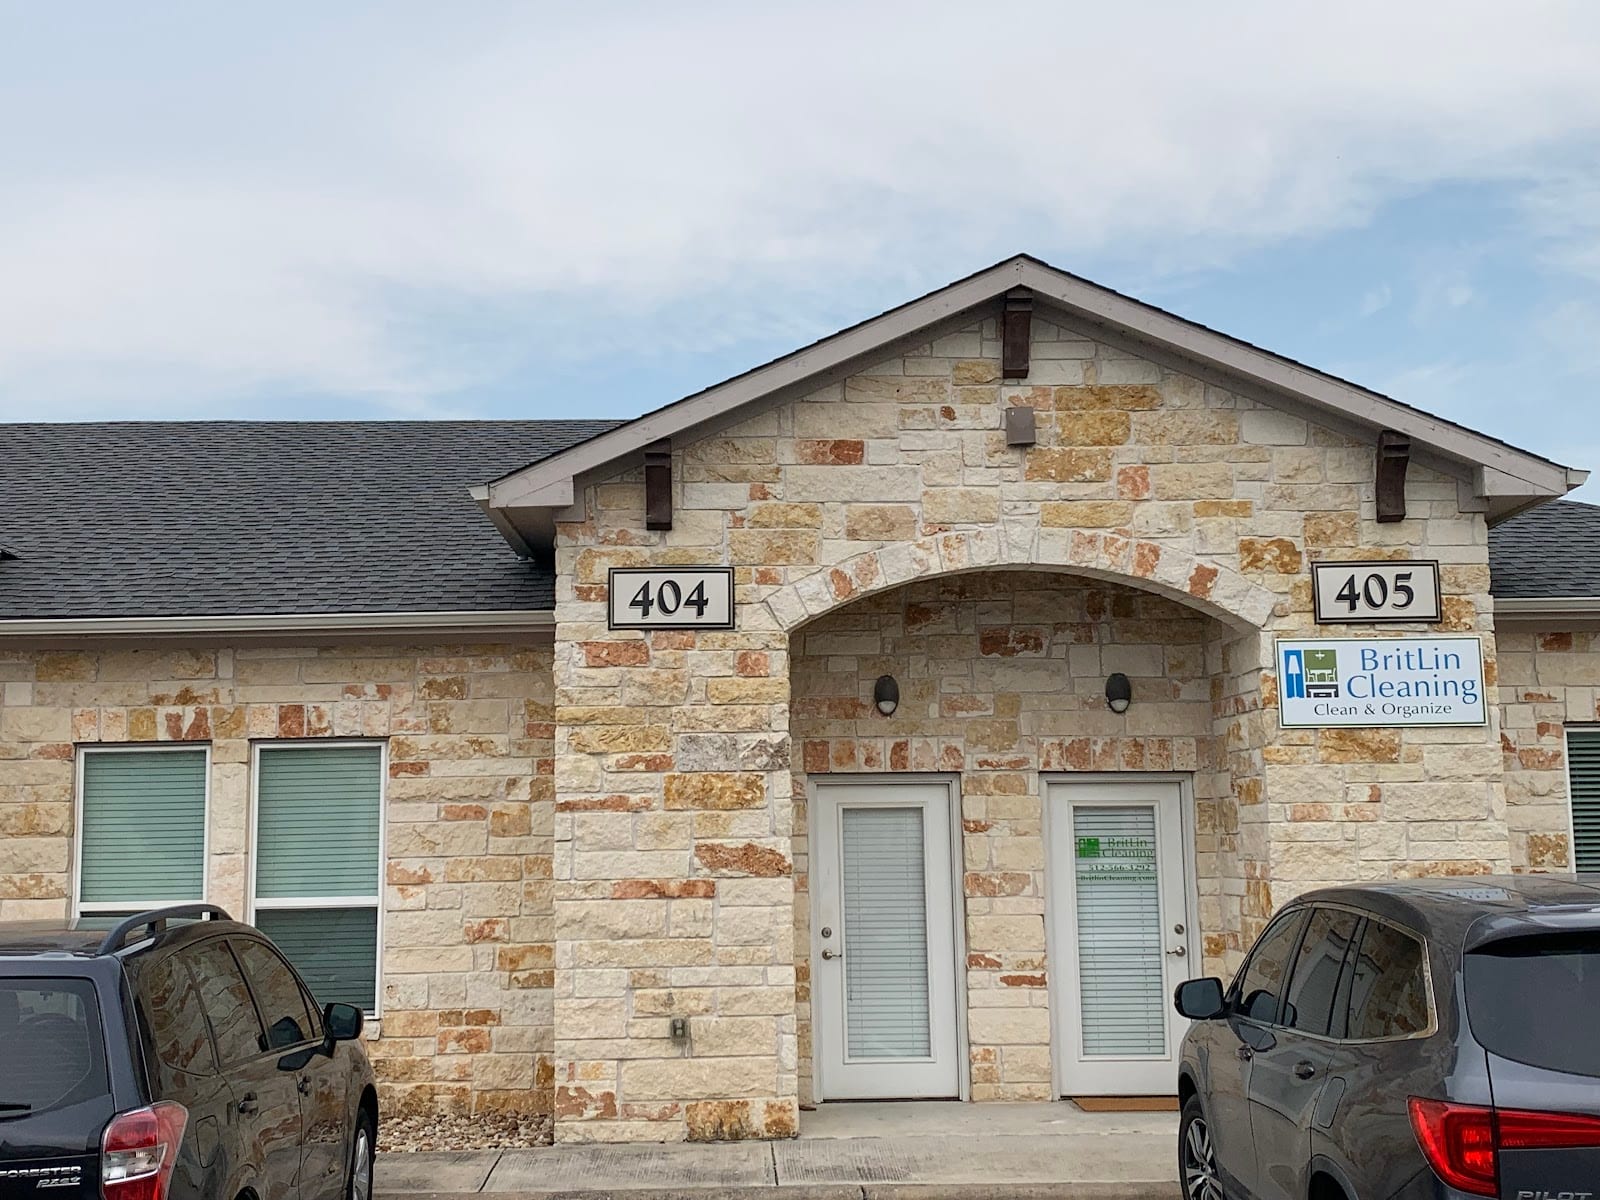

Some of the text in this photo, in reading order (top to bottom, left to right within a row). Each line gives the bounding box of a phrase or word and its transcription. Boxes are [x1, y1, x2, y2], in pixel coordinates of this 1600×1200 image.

[629, 580, 709, 619] 404
[1335, 572, 1415, 613] 405
[1360, 647, 1461, 671] BritLin
[1347, 673, 1478, 705] Cleaning
[1314, 702, 1452, 718] Clean & Organize
[1102, 848, 1154, 861] Cleaning
[0, 1166, 81, 1178] FORESTER
[1517, 1191, 1593, 1200] PILOT
